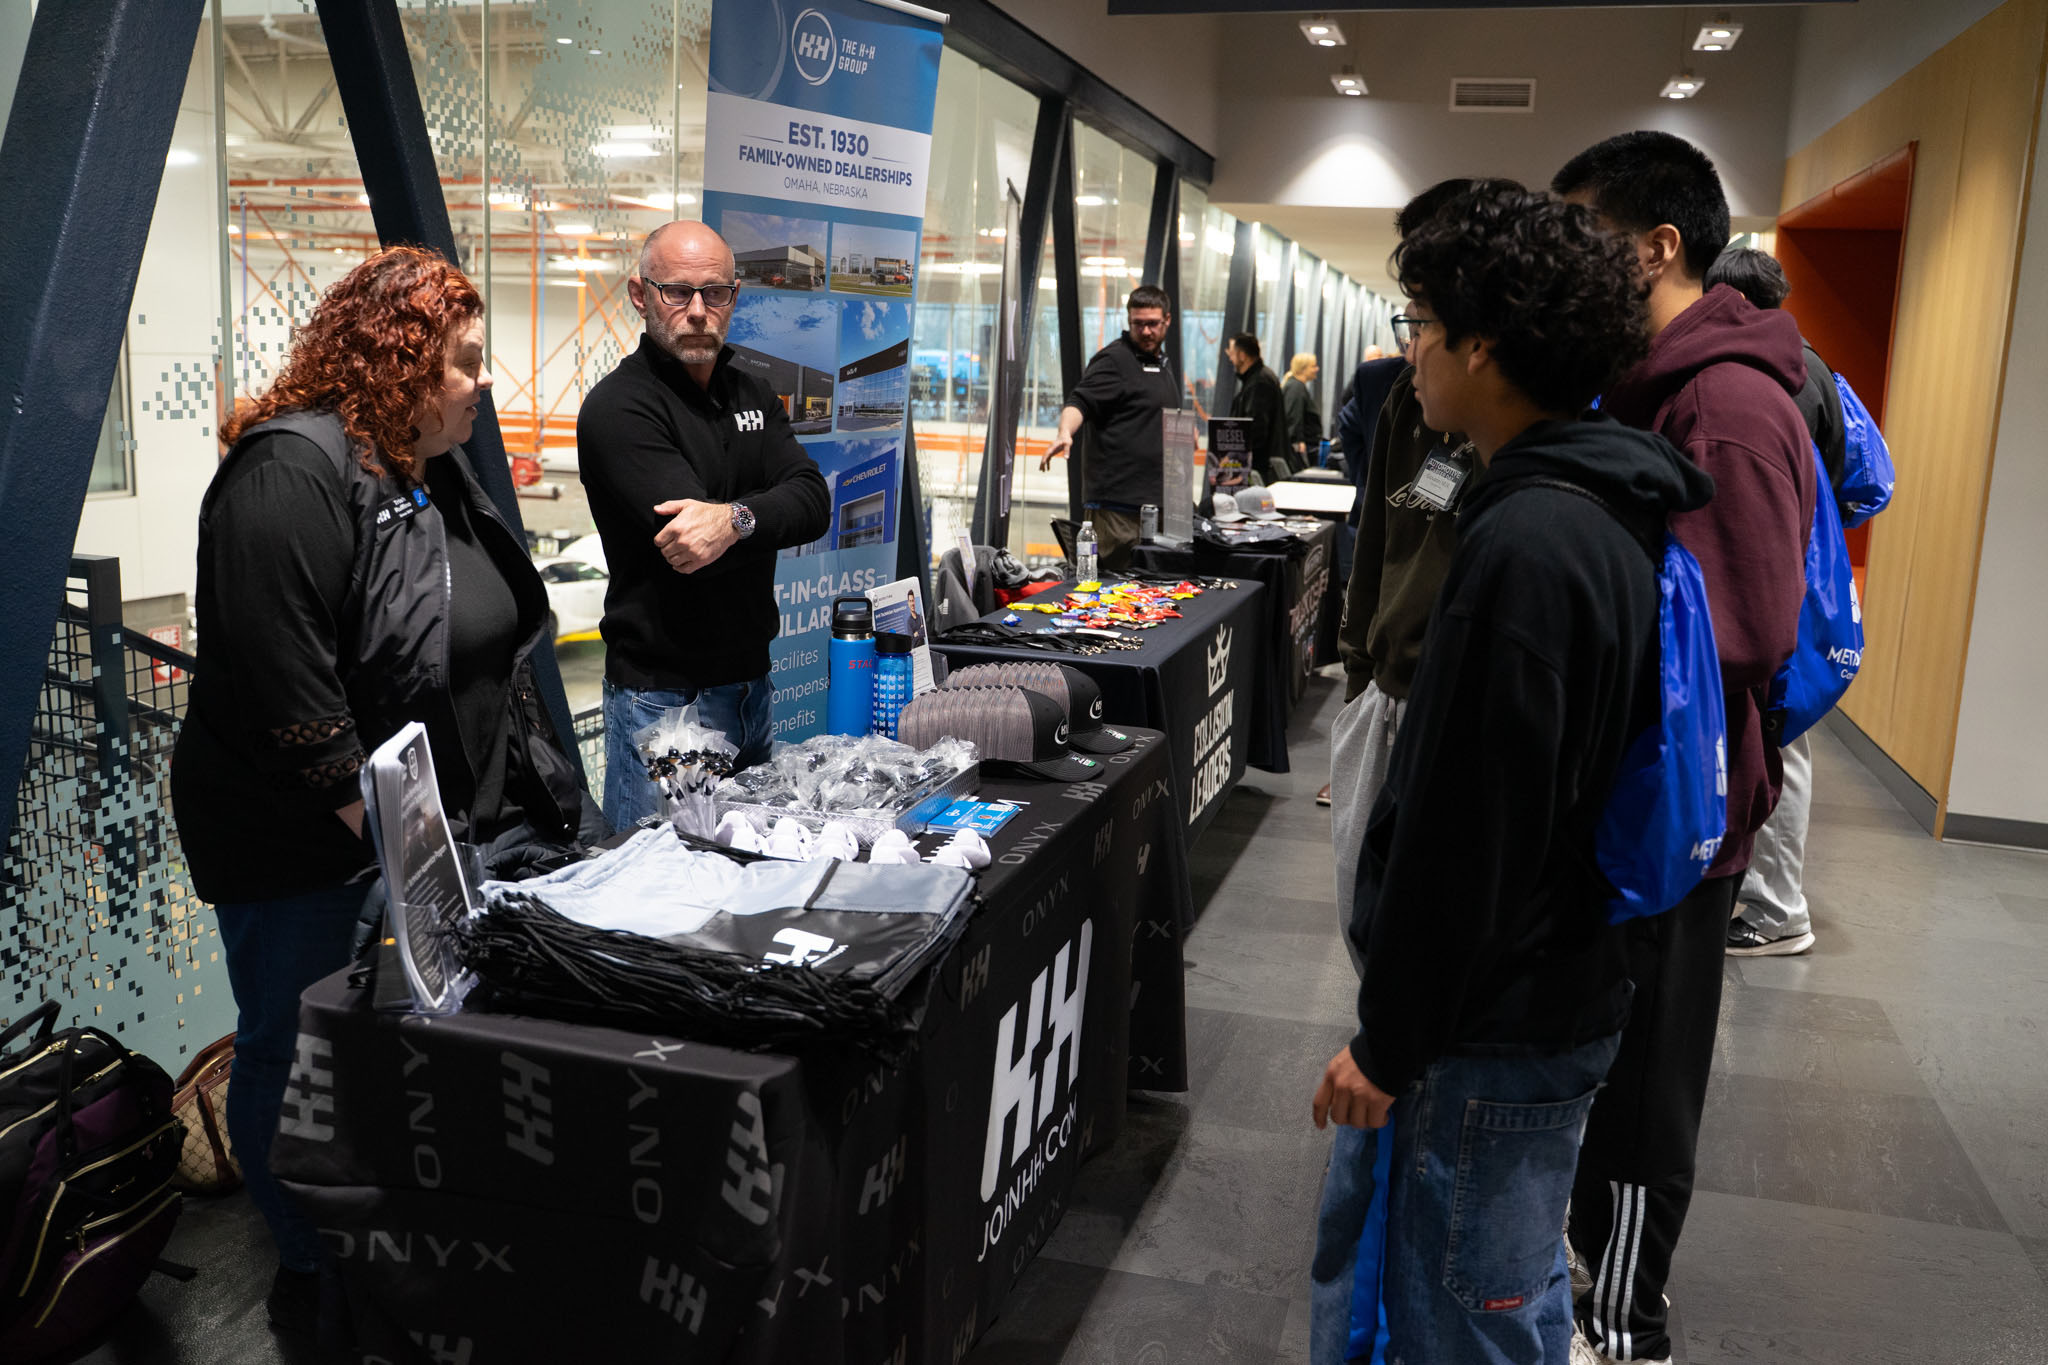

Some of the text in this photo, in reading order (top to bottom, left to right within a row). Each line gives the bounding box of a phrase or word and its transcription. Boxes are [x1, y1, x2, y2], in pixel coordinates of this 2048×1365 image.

[838, 56, 868, 75] GROUP
[842, 39, 876, 59] THE H+H
[788, 122, 869, 157] EST. 1930
[739, 145, 912, 187] FAMILY-OWNED DEALERSHIPS
[784, 177, 868, 199] OMAHA, NEBRASKA
[1217, 429, 1245, 443] DIESEL
[852, 463, 887, 484] CHEVROLET
[773, 568, 875, 607] T-IN-CLASS
[779, 605, 831, 638] ILLAR
[771, 649, 818, 673] acilites
[772, 709, 816, 735] enefits
[1194, 688, 1234, 767] COLLISION
[1109, 735, 1157, 764] ONX
[1189, 735, 1232, 825] LEADERS
[1133, 777, 1169, 820] ONYX
[999, 821, 1063, 864] ONYX
[1022, 871, 1071, 937] ONYX
[977, 1092, 1077, 1263] JOINHH.COM
